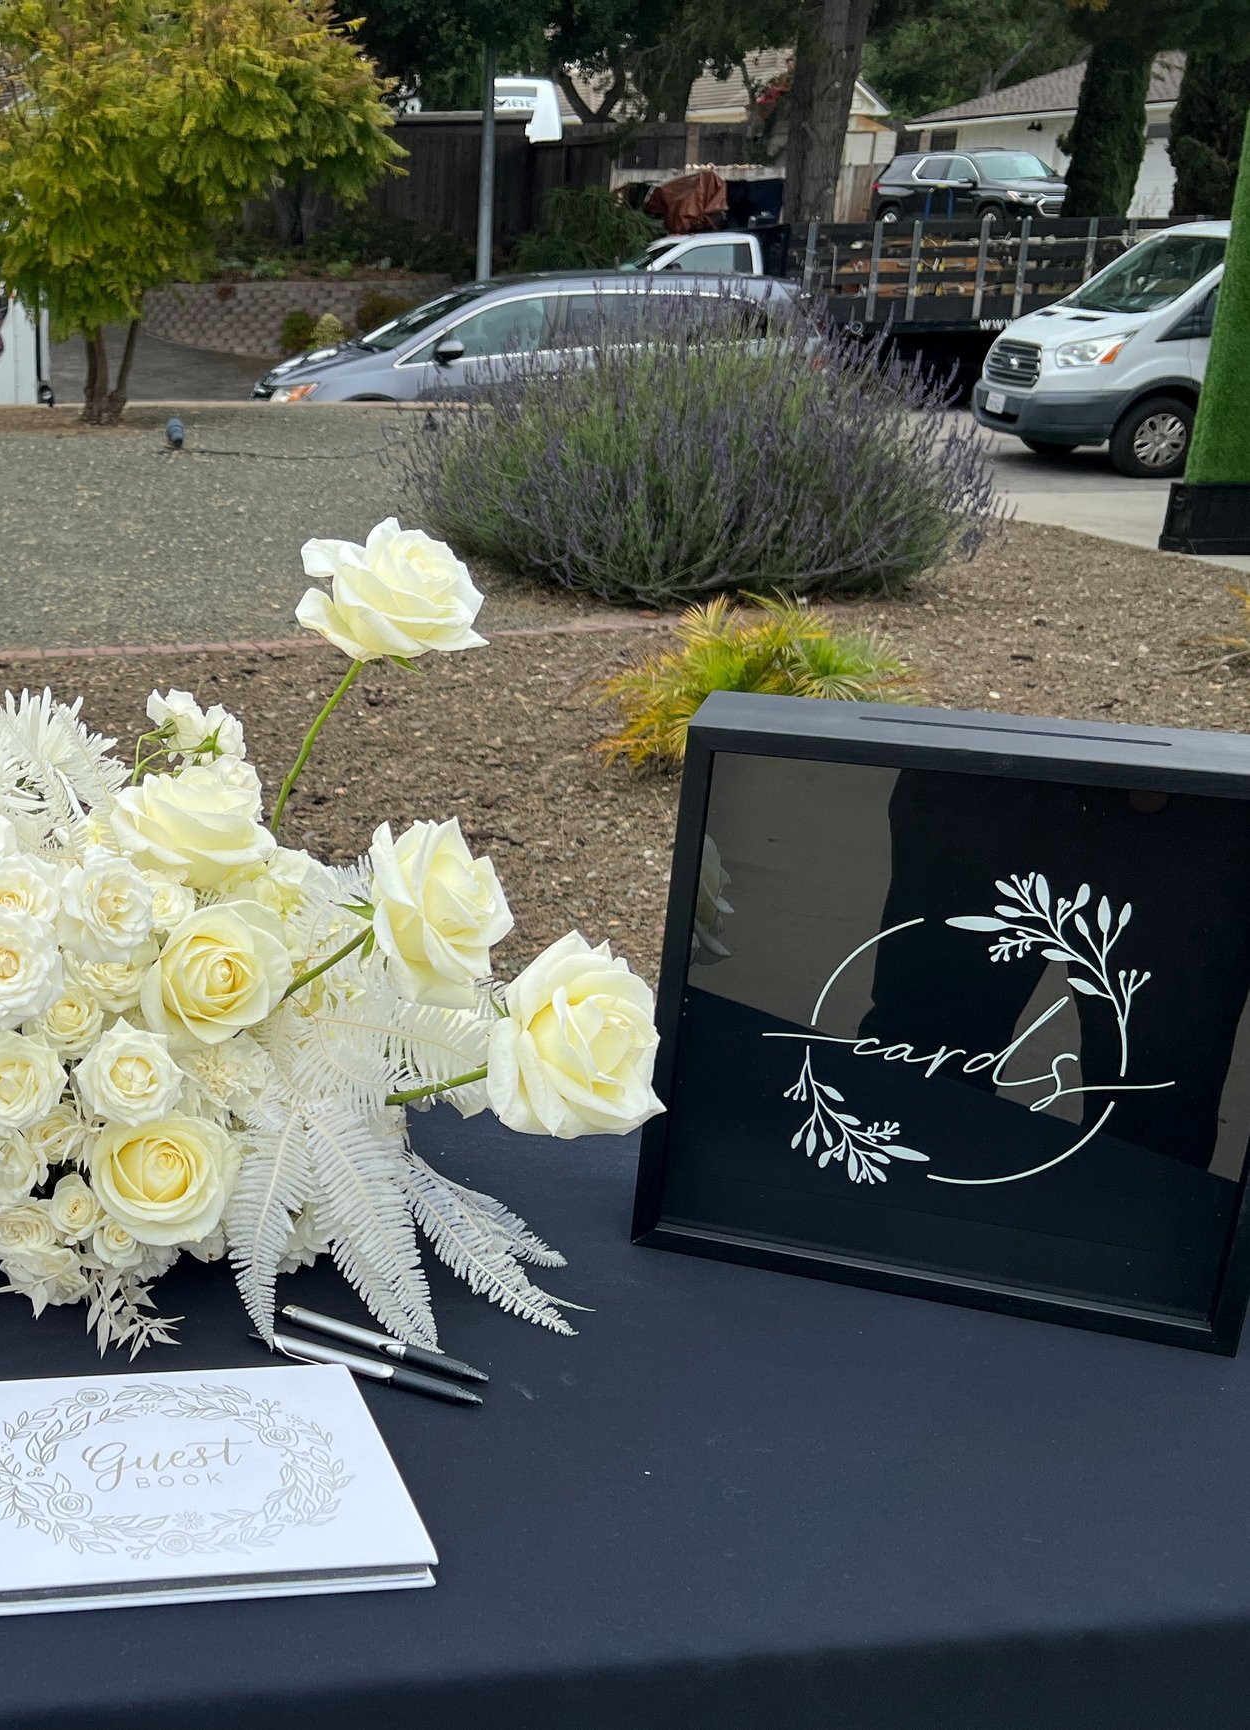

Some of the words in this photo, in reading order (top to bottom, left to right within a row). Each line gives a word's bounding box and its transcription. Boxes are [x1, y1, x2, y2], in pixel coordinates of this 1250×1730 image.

[762, 995, 1176, 1111] cards
[81, 1438, 252, 1492] Guest
[135, 1472, 224, 1489] BOOK
